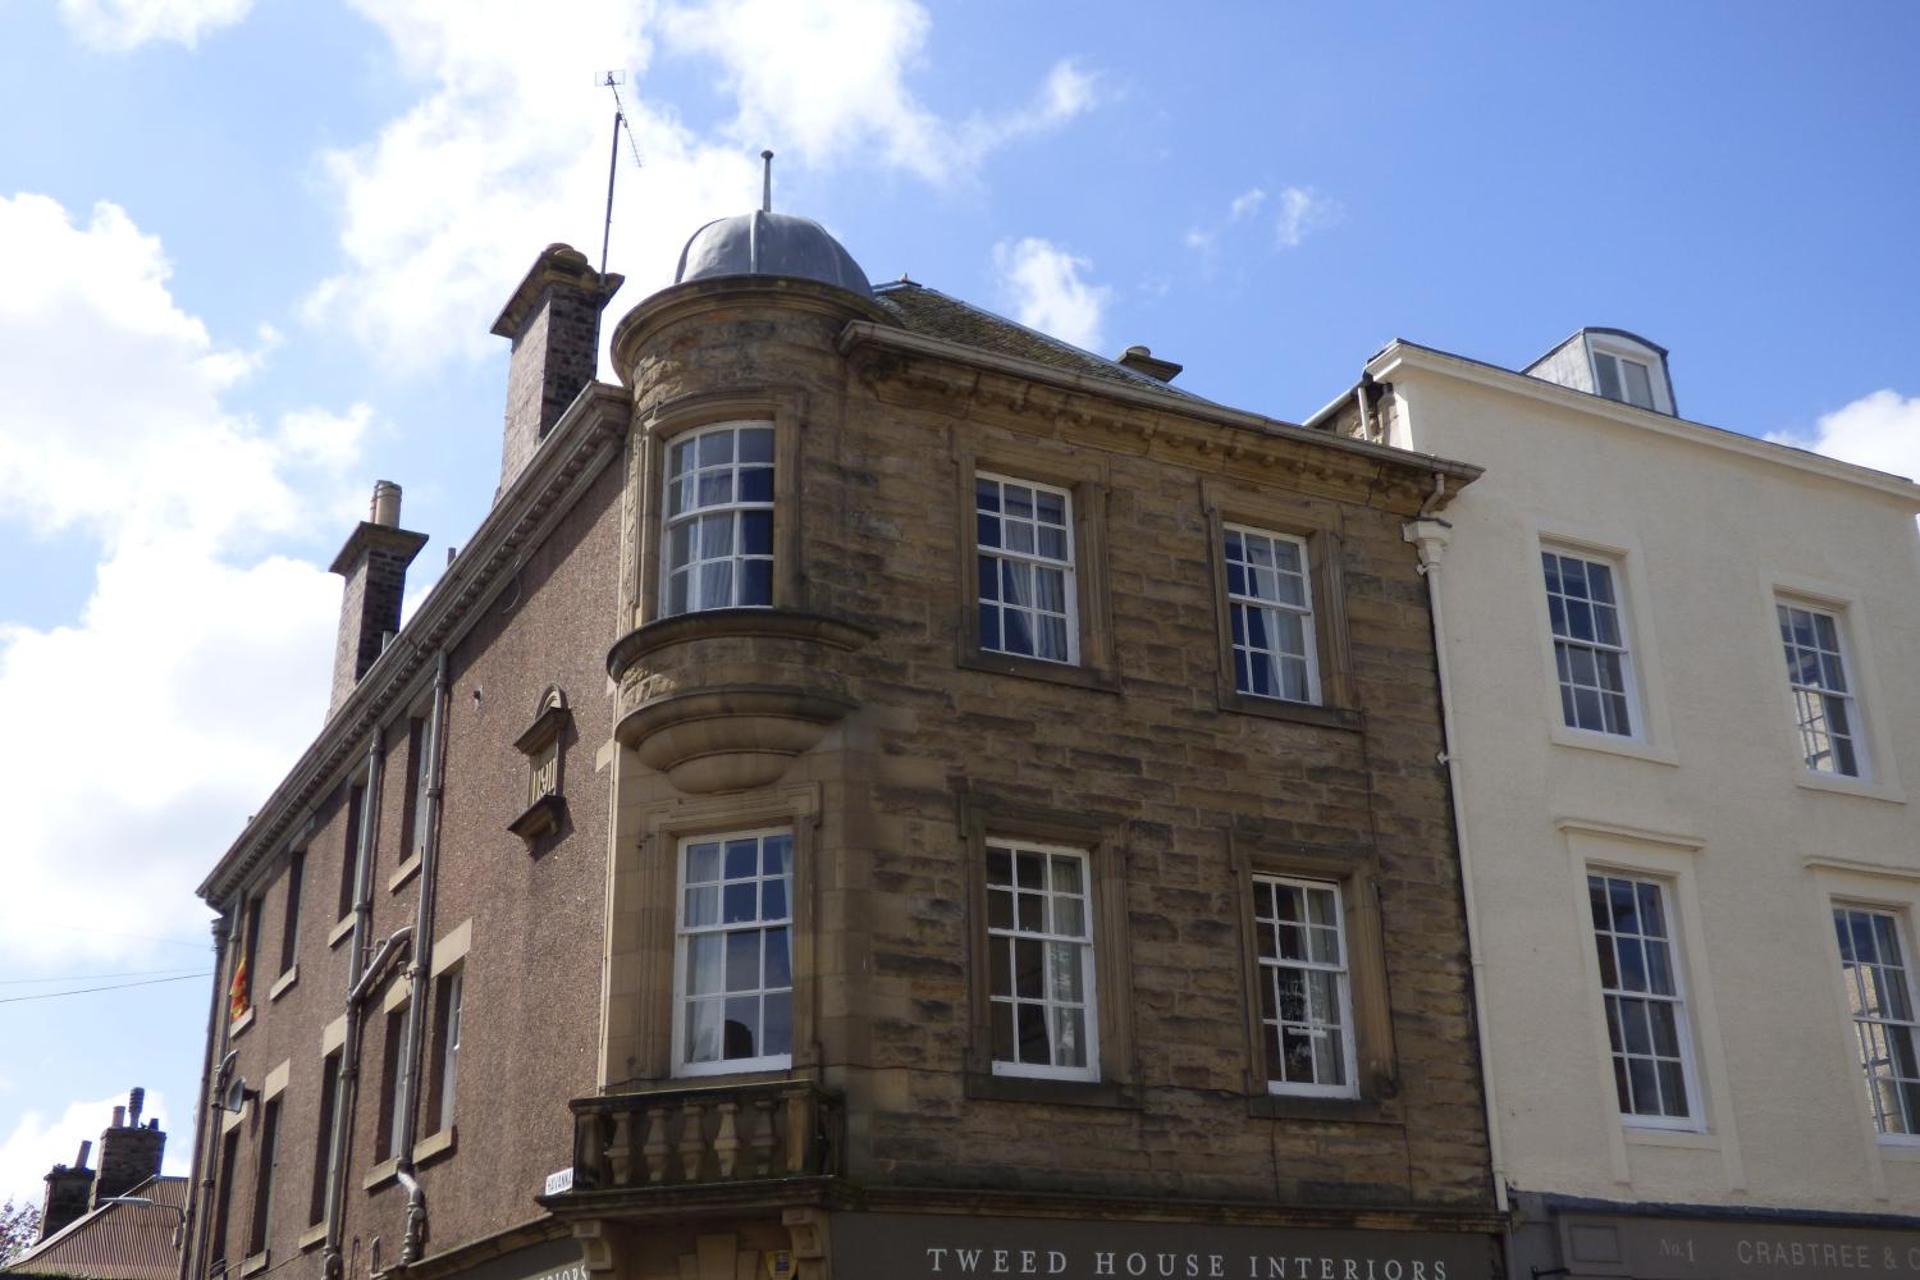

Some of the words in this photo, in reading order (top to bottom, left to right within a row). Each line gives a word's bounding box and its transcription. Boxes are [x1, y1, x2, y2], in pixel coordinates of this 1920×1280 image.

[927, 1249, 1067, 1274] TWEED
[1095, 1252, 1225, 1278] HOUSE
[1250, 1256, 1447, 1280] INTERIORS
[1736, 1239, 1872, 1269] CRABTREE
[1883, 1246, 1897, 1271] &
